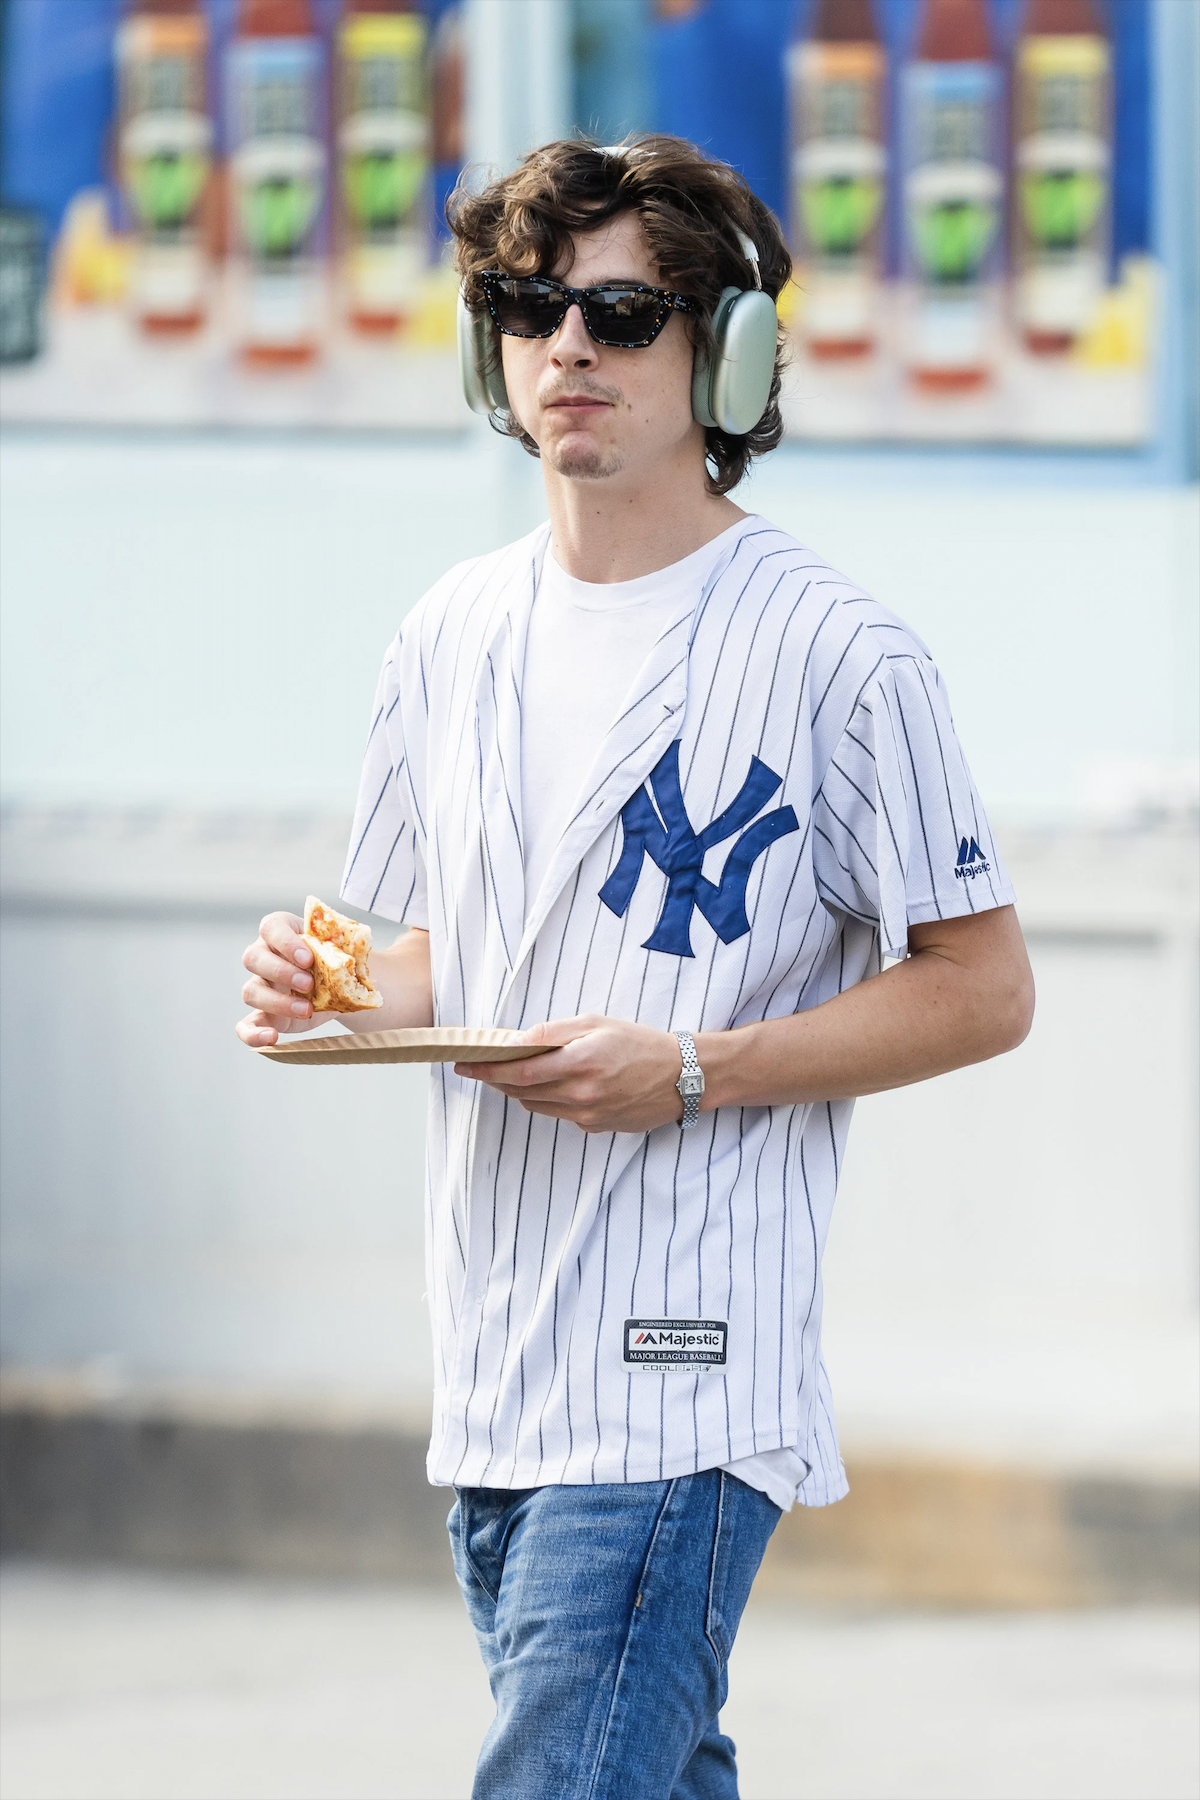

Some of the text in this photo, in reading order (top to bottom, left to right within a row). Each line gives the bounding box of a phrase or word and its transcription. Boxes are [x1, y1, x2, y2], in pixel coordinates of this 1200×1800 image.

[597, 738, 801, 959] NY
[953, 861, 991, 880] Majestic
[659, 1332, 720, 1349] Majestic
[629, 1352, 722, 1362] MAJOR LEAGUE BASEBALL
